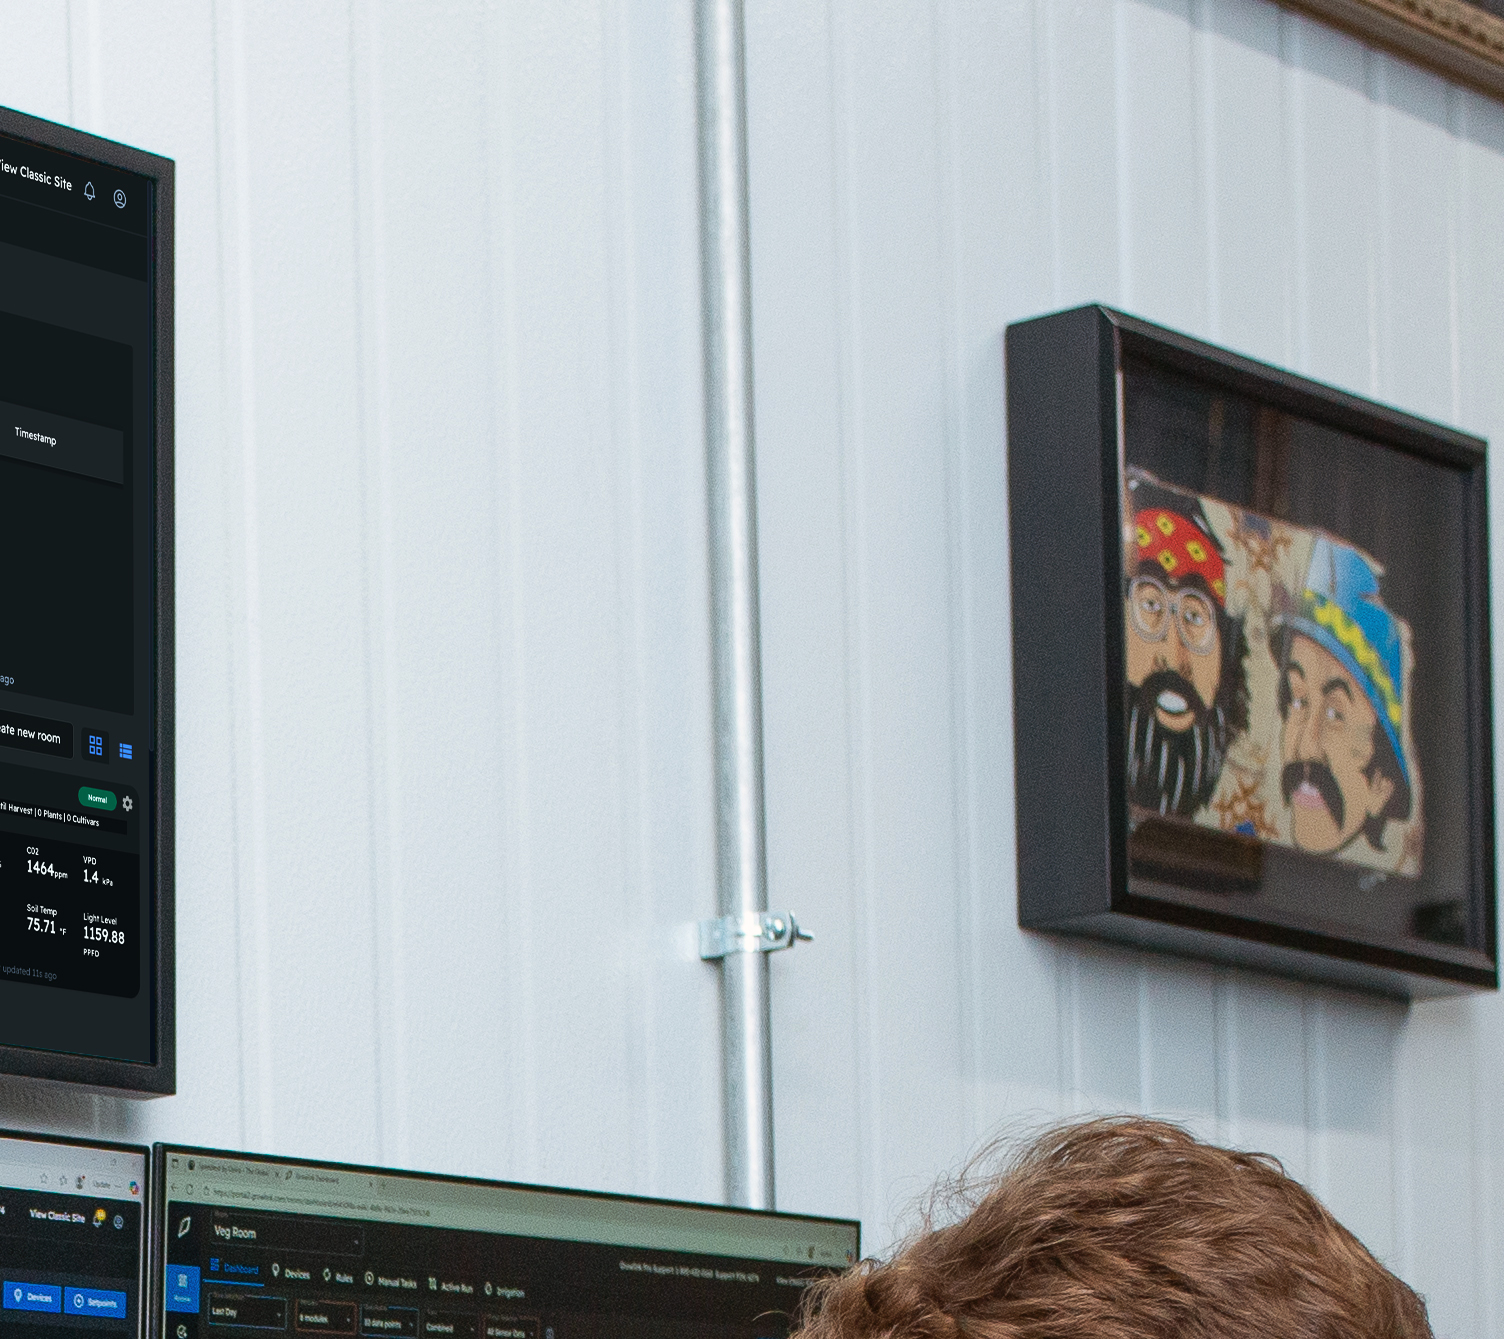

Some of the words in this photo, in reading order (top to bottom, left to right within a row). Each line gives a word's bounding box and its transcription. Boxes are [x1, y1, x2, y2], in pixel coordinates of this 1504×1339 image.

[20, 166, 51, 185] Classic
[54, 176, 72, 191] Site
[15, 427, 56, 447] Timestamp
[17, 728, 35, 738] new
[38, 732, 60, 744] room
[84, 926, 125, 944] 1159.88
[214, 1225, 231, 1239] Veg
[232, 1226, 256, 1238] Room
